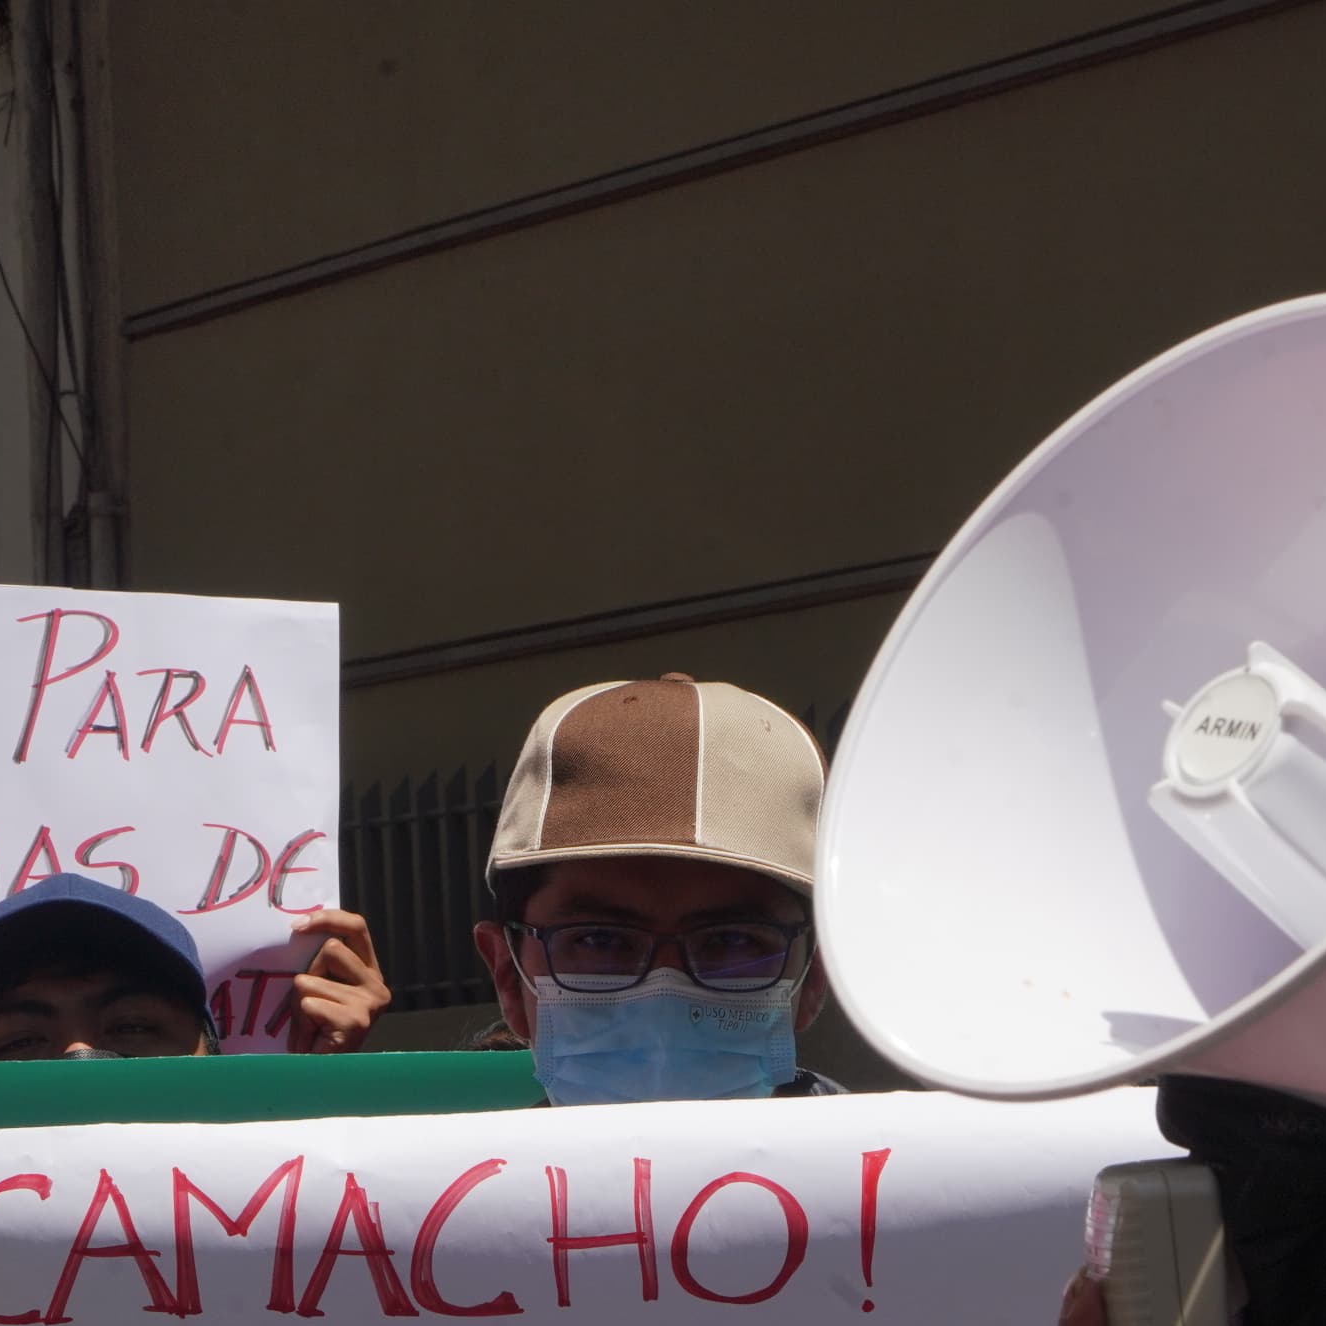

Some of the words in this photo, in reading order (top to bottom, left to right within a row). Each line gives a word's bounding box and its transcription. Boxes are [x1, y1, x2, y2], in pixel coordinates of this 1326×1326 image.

[15, 607, 278, 764] PARA
[1194, 715, 1263, 742] ARMIN
[177, 823, 329, 916] DE
